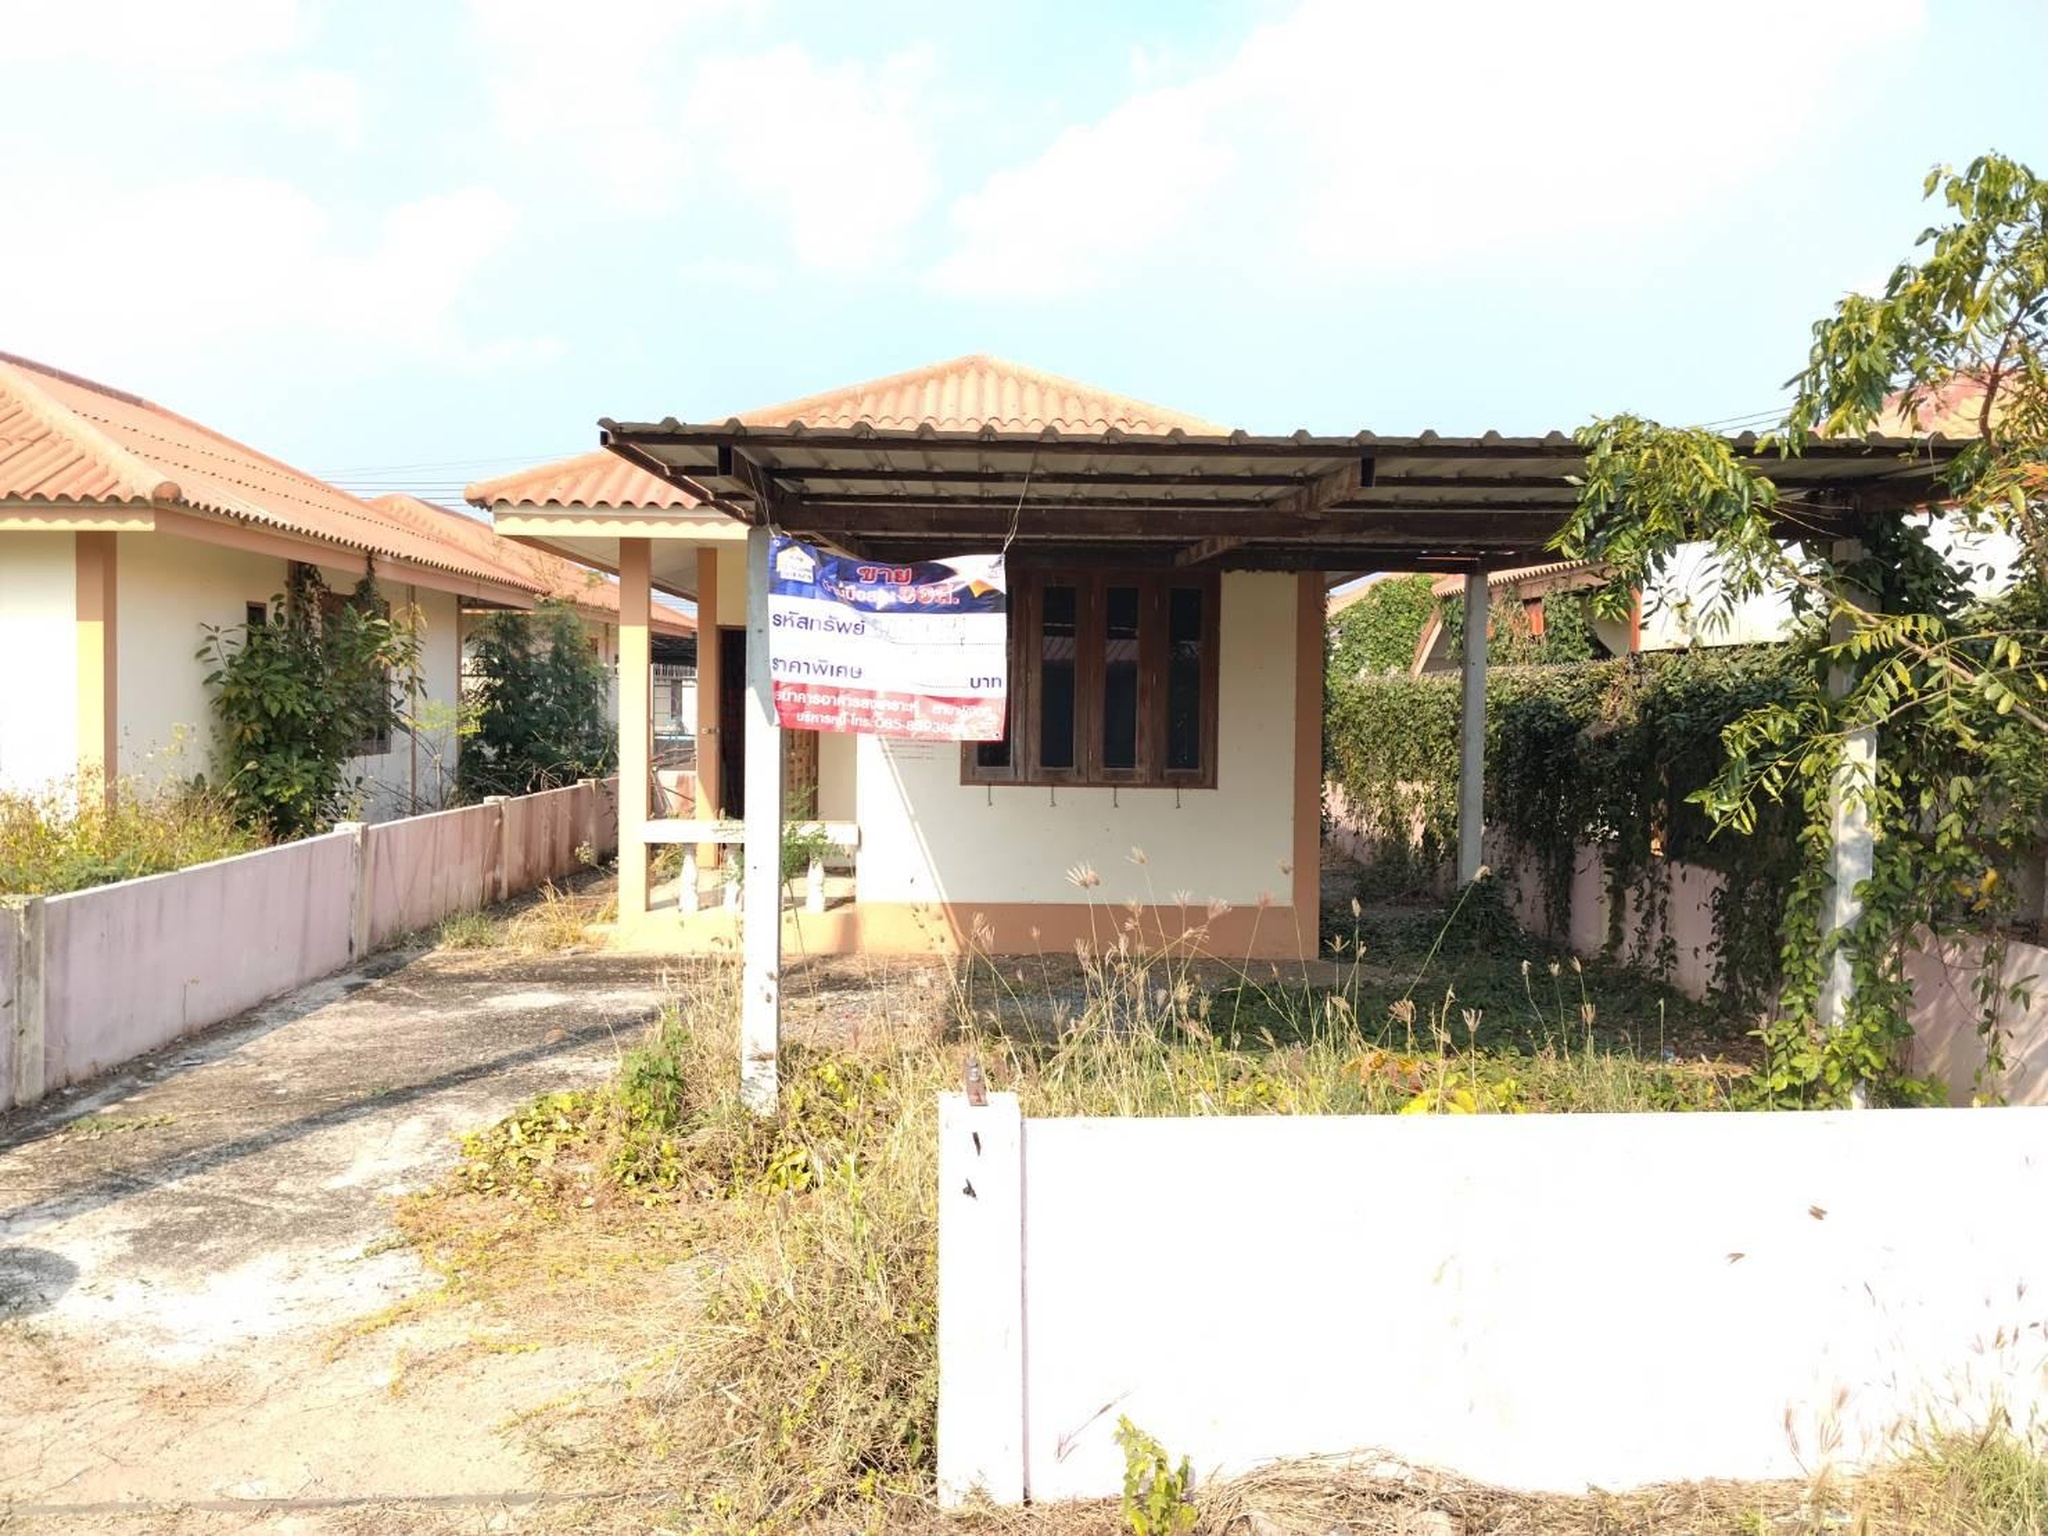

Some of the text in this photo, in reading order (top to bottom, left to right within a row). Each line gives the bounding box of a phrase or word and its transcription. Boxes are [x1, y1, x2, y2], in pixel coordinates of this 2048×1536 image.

[857, 566, 912, 585] ขาย
[772, 611, 866, 636] รหัสทรัพย์
[772, 657, 863, 679] ราคาพิเศษ
[970, 677, 1002, 689] บาท
